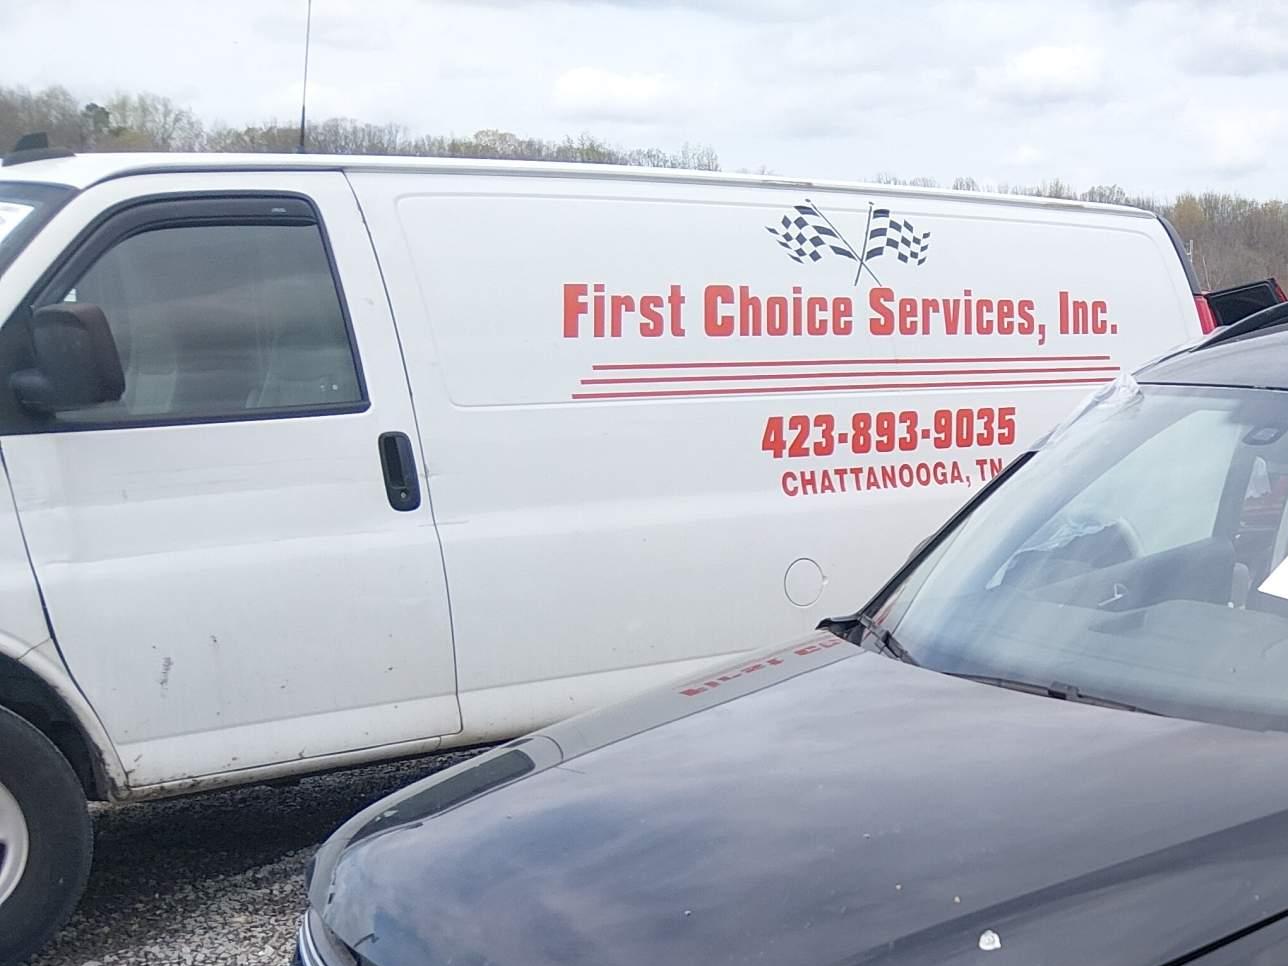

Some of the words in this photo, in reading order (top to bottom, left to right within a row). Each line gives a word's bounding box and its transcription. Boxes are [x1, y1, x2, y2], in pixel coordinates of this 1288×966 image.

[562, 283, 686, 338] First
[704, 284, 853, 337] Choice
[868, 287, 1047, 346] Services,
[1058, 291, 1118, 335] Inc.
[761, 406, 1017, 459] 423-893-9035
[781, 460, 972, 497] CHATTANOOGA,
